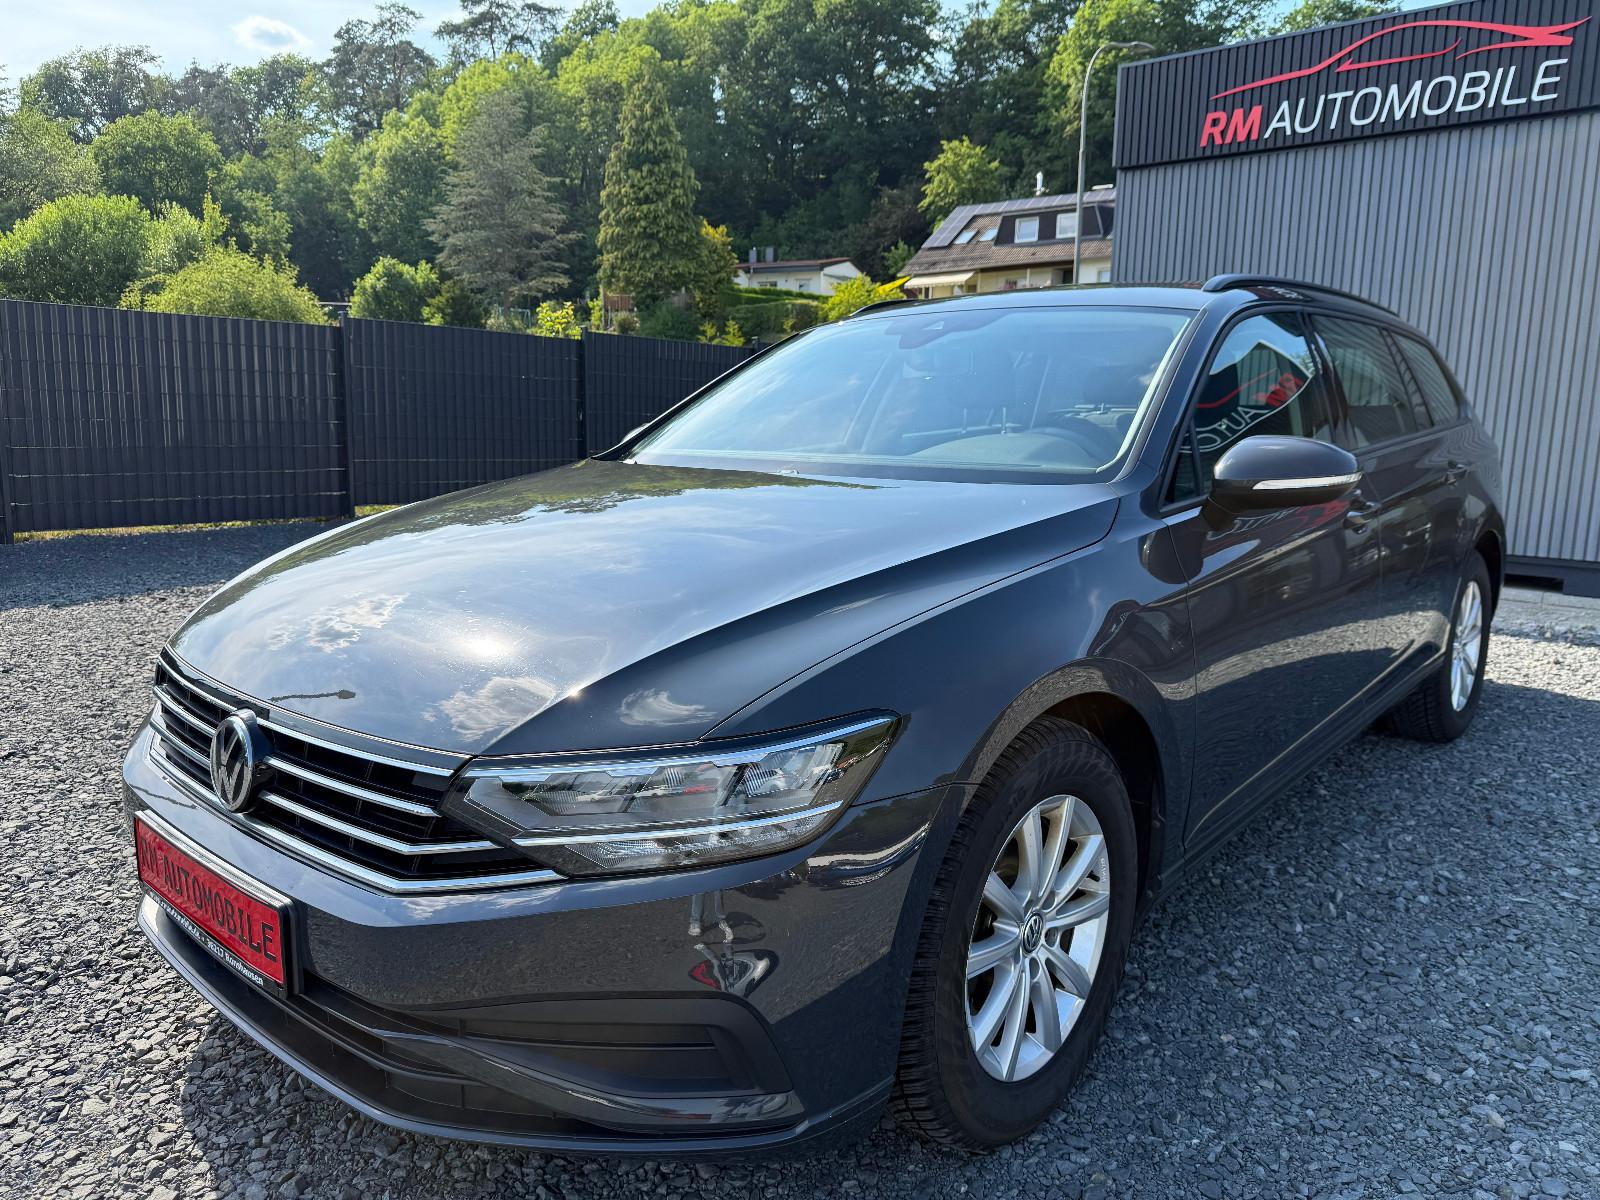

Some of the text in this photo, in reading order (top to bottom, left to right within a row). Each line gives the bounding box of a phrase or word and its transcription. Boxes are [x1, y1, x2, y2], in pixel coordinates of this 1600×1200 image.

[1200, 58, 1568, 148] RM AUTOMOBILE
[162, 856, 277, 963] AUTOMOBILE
